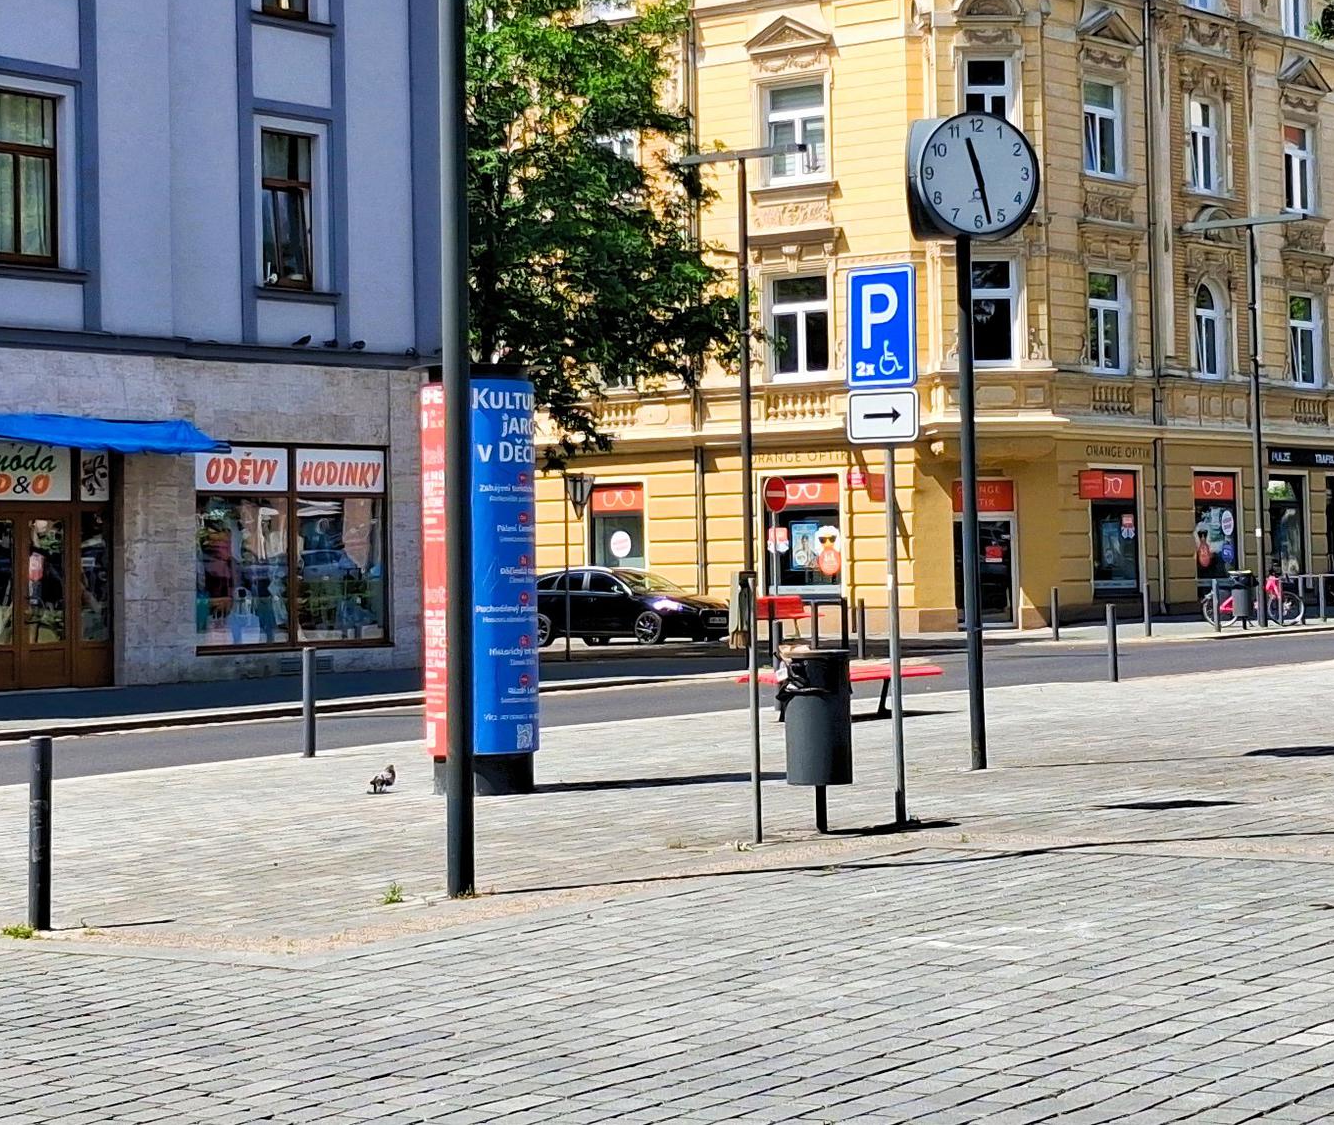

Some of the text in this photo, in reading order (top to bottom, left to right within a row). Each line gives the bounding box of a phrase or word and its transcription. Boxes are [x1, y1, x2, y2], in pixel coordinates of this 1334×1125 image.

[948, 124, 960, 138] 11
[969, 118, 984, 133] 12
[996, 125, 1002, 139] 1
[931, 143, 947, 157] 10
[1012, 143, 1022, 156] 2
[924, 166, 934, 180] 9
[1020, 166, 1030, 181] 3
[933, 191, 943, 205] 8
[1013, 191, 1023, 205] 4
[951, 208, 960, 222] 7
[973, 215, 983, 229] 6
[996, 209, 1006, 223] 5
[861, 283, 898, 349] P
[855, 361, 875, 377] 2x
[477, 444, 493, 463] v
[807, 449, 848, 462] OPTIK
[1086, 444, 1121, 458] ORANGE
[205, 451, 278, 486] ODĚVY
[300, 460, 381, 489] HODINKY
[956, 485, 1001, 494] ONGE
